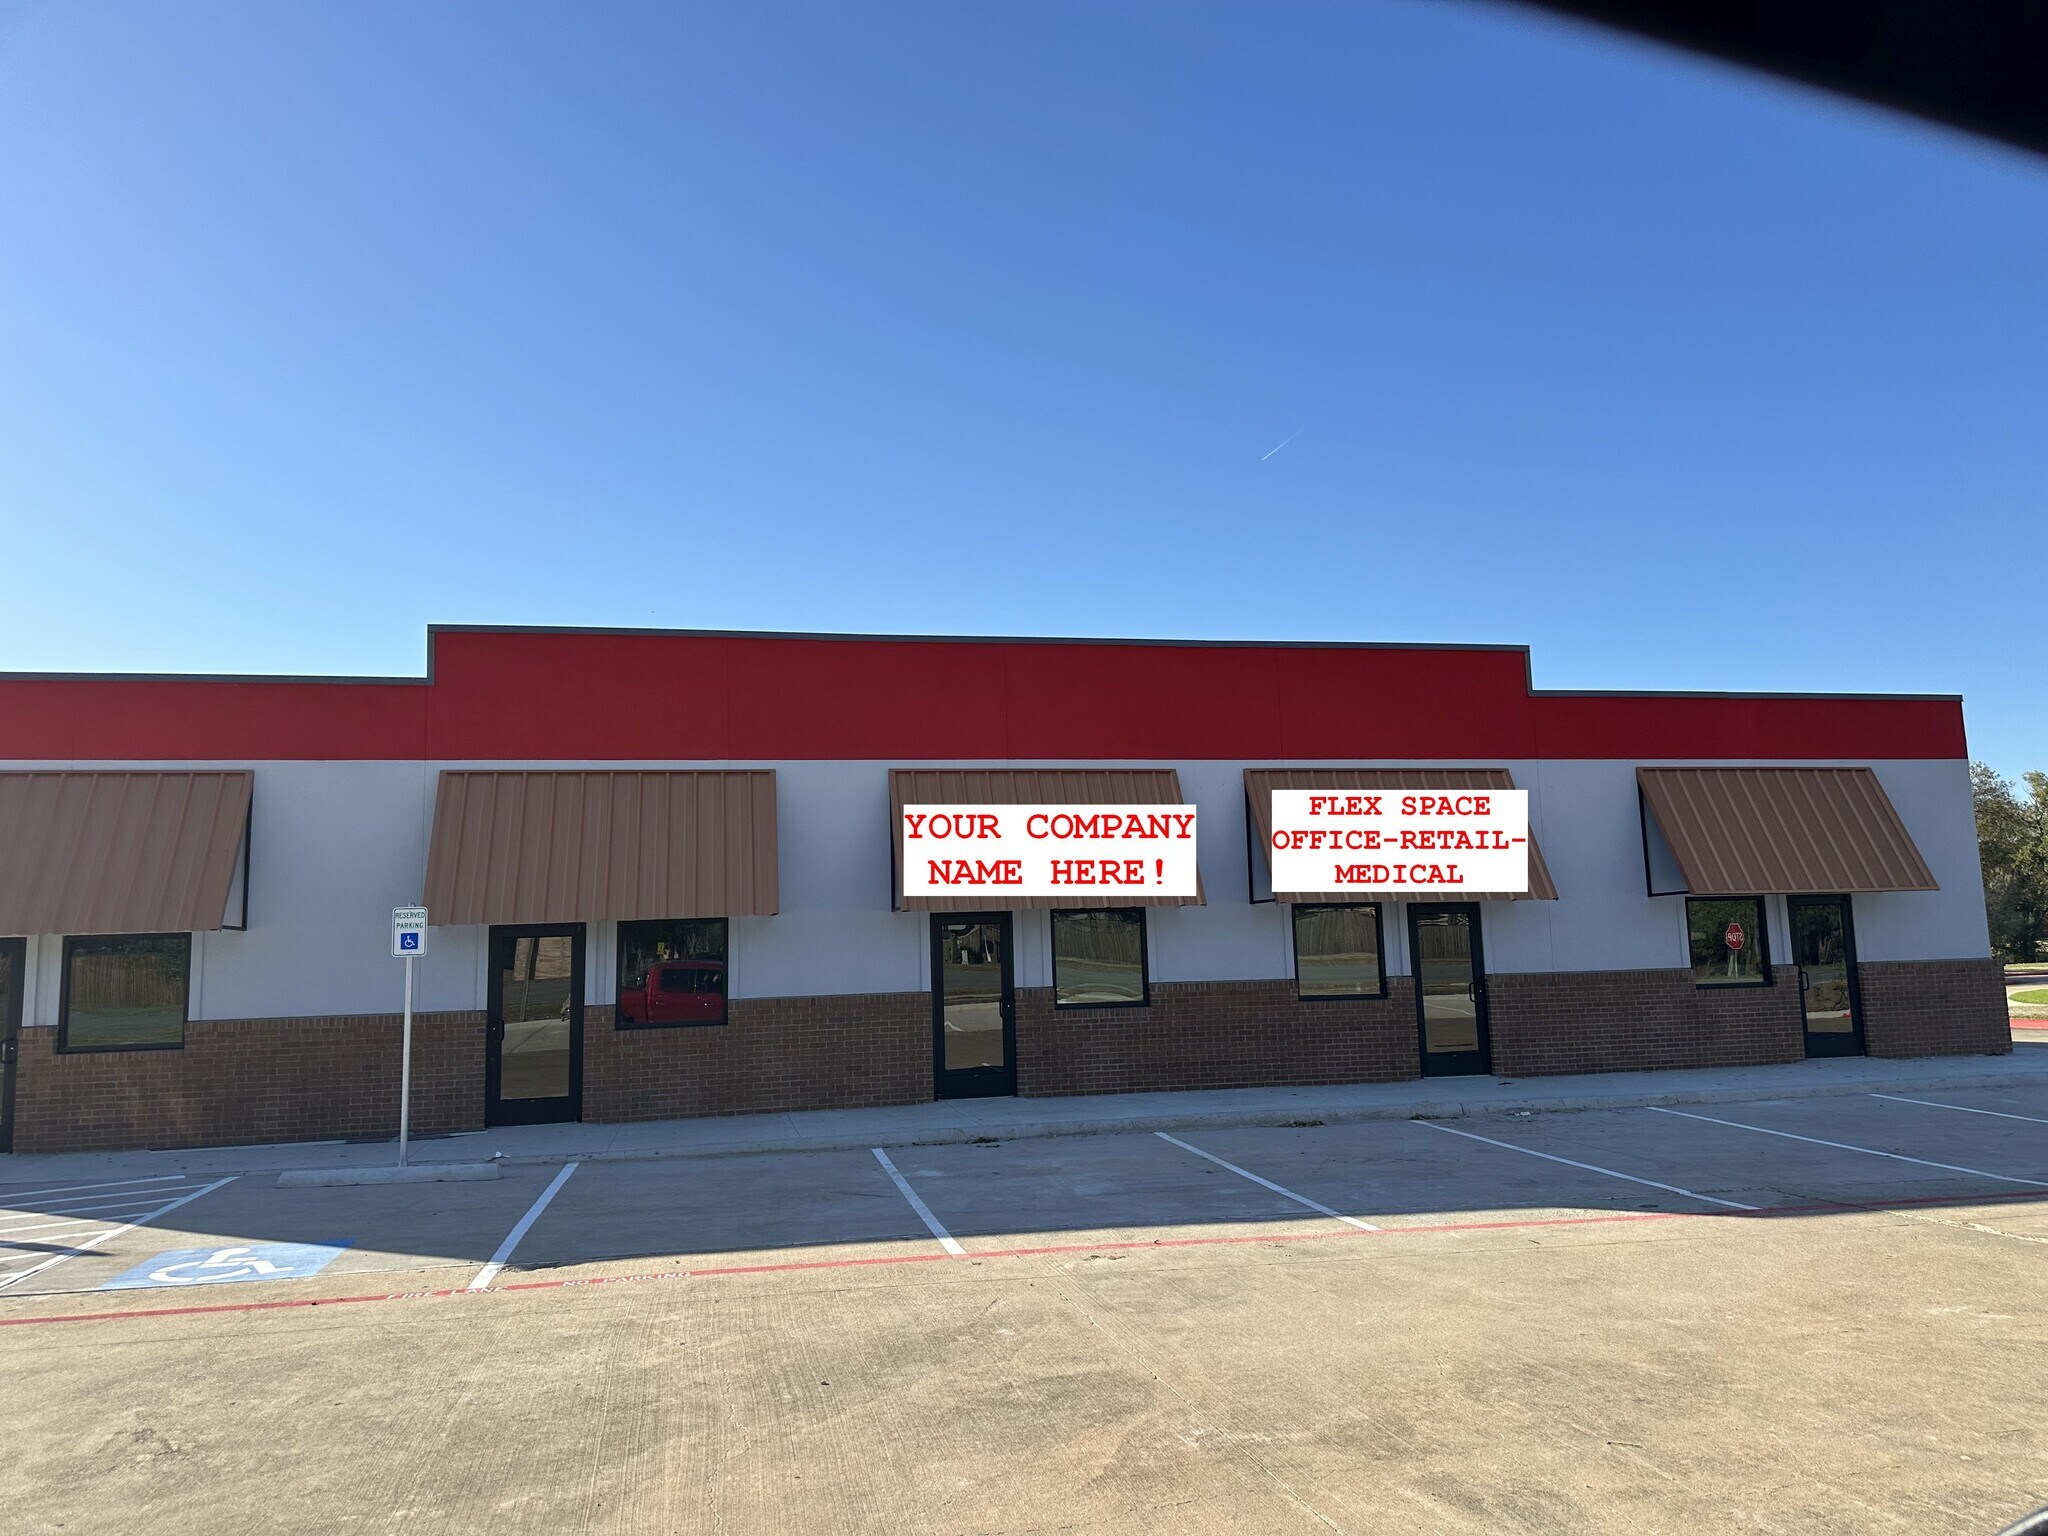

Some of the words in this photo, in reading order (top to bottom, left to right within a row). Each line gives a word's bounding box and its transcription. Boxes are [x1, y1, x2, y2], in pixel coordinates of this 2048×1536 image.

[395, 911, 425, 919] RESERVED
[386, 1292, 435, 1300] FIRE
[602, 1271, 691, 1284] PARKING
